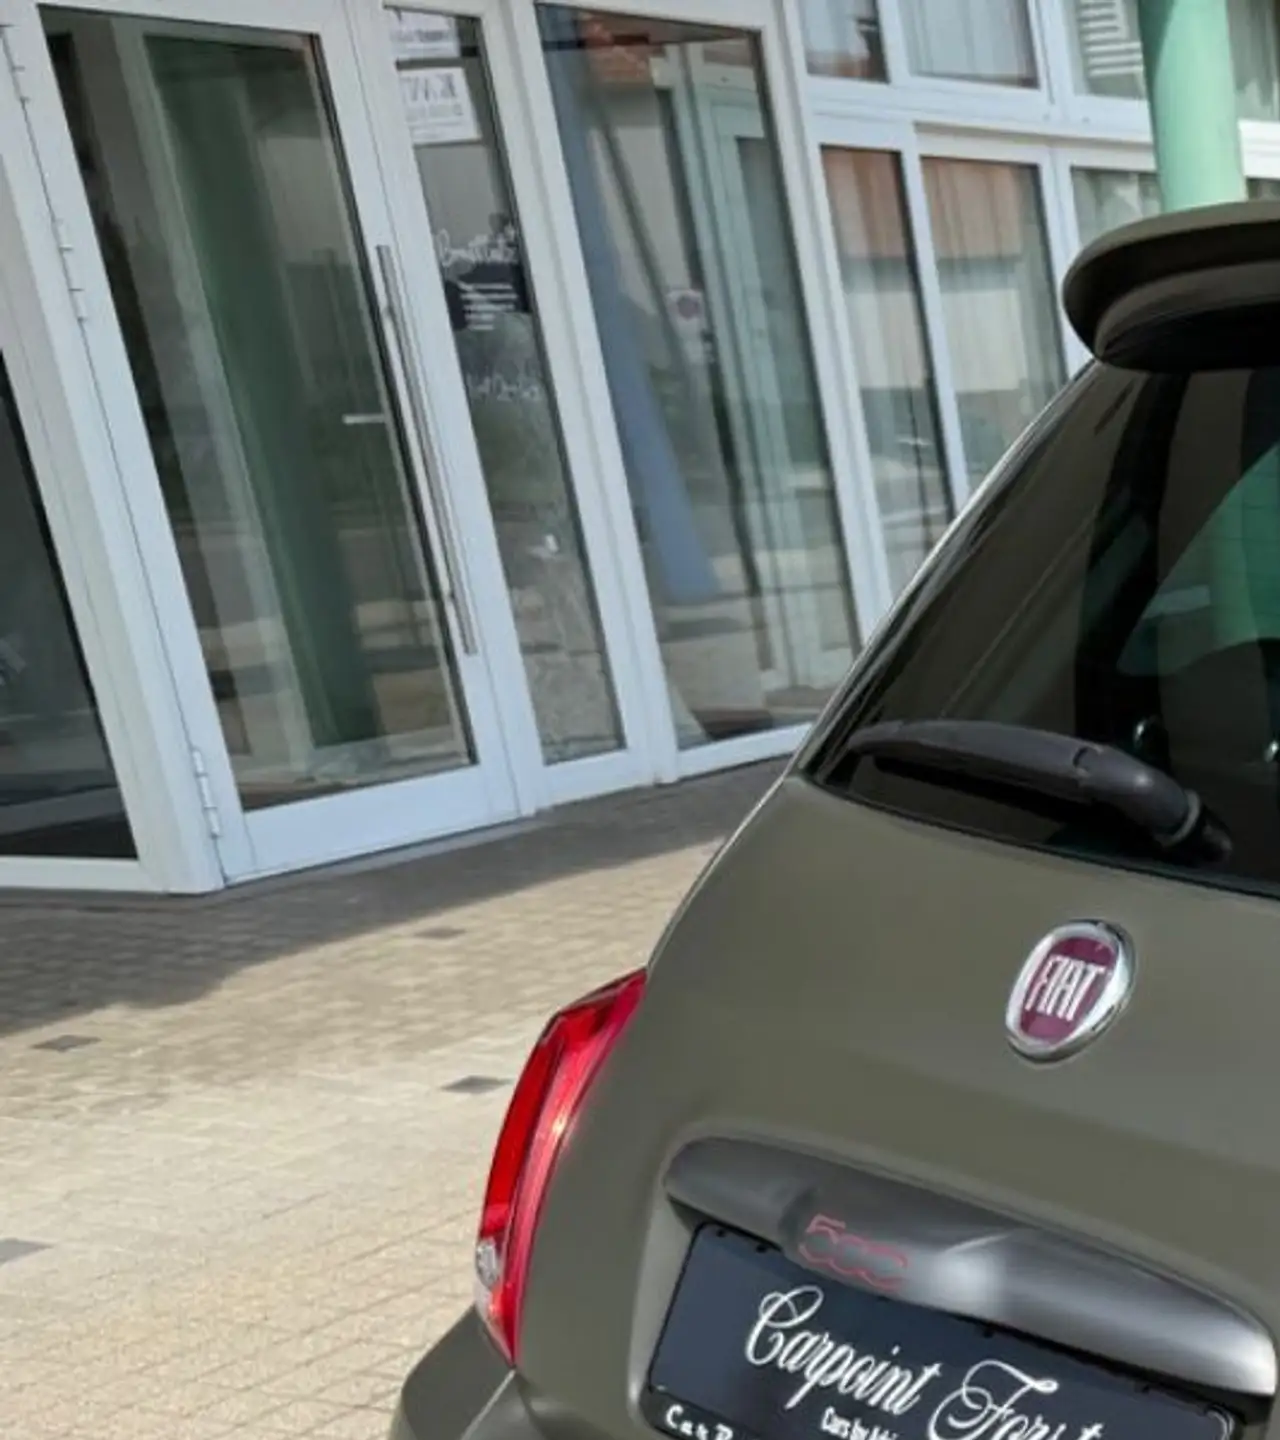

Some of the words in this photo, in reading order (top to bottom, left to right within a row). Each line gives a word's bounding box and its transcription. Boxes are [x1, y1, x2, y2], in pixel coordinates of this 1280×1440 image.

[1024, 954, 1107, 1022] FIAT
[798, 1212, 909, 1293] 500
[745, 1284, 942, 1411] Carpoint
